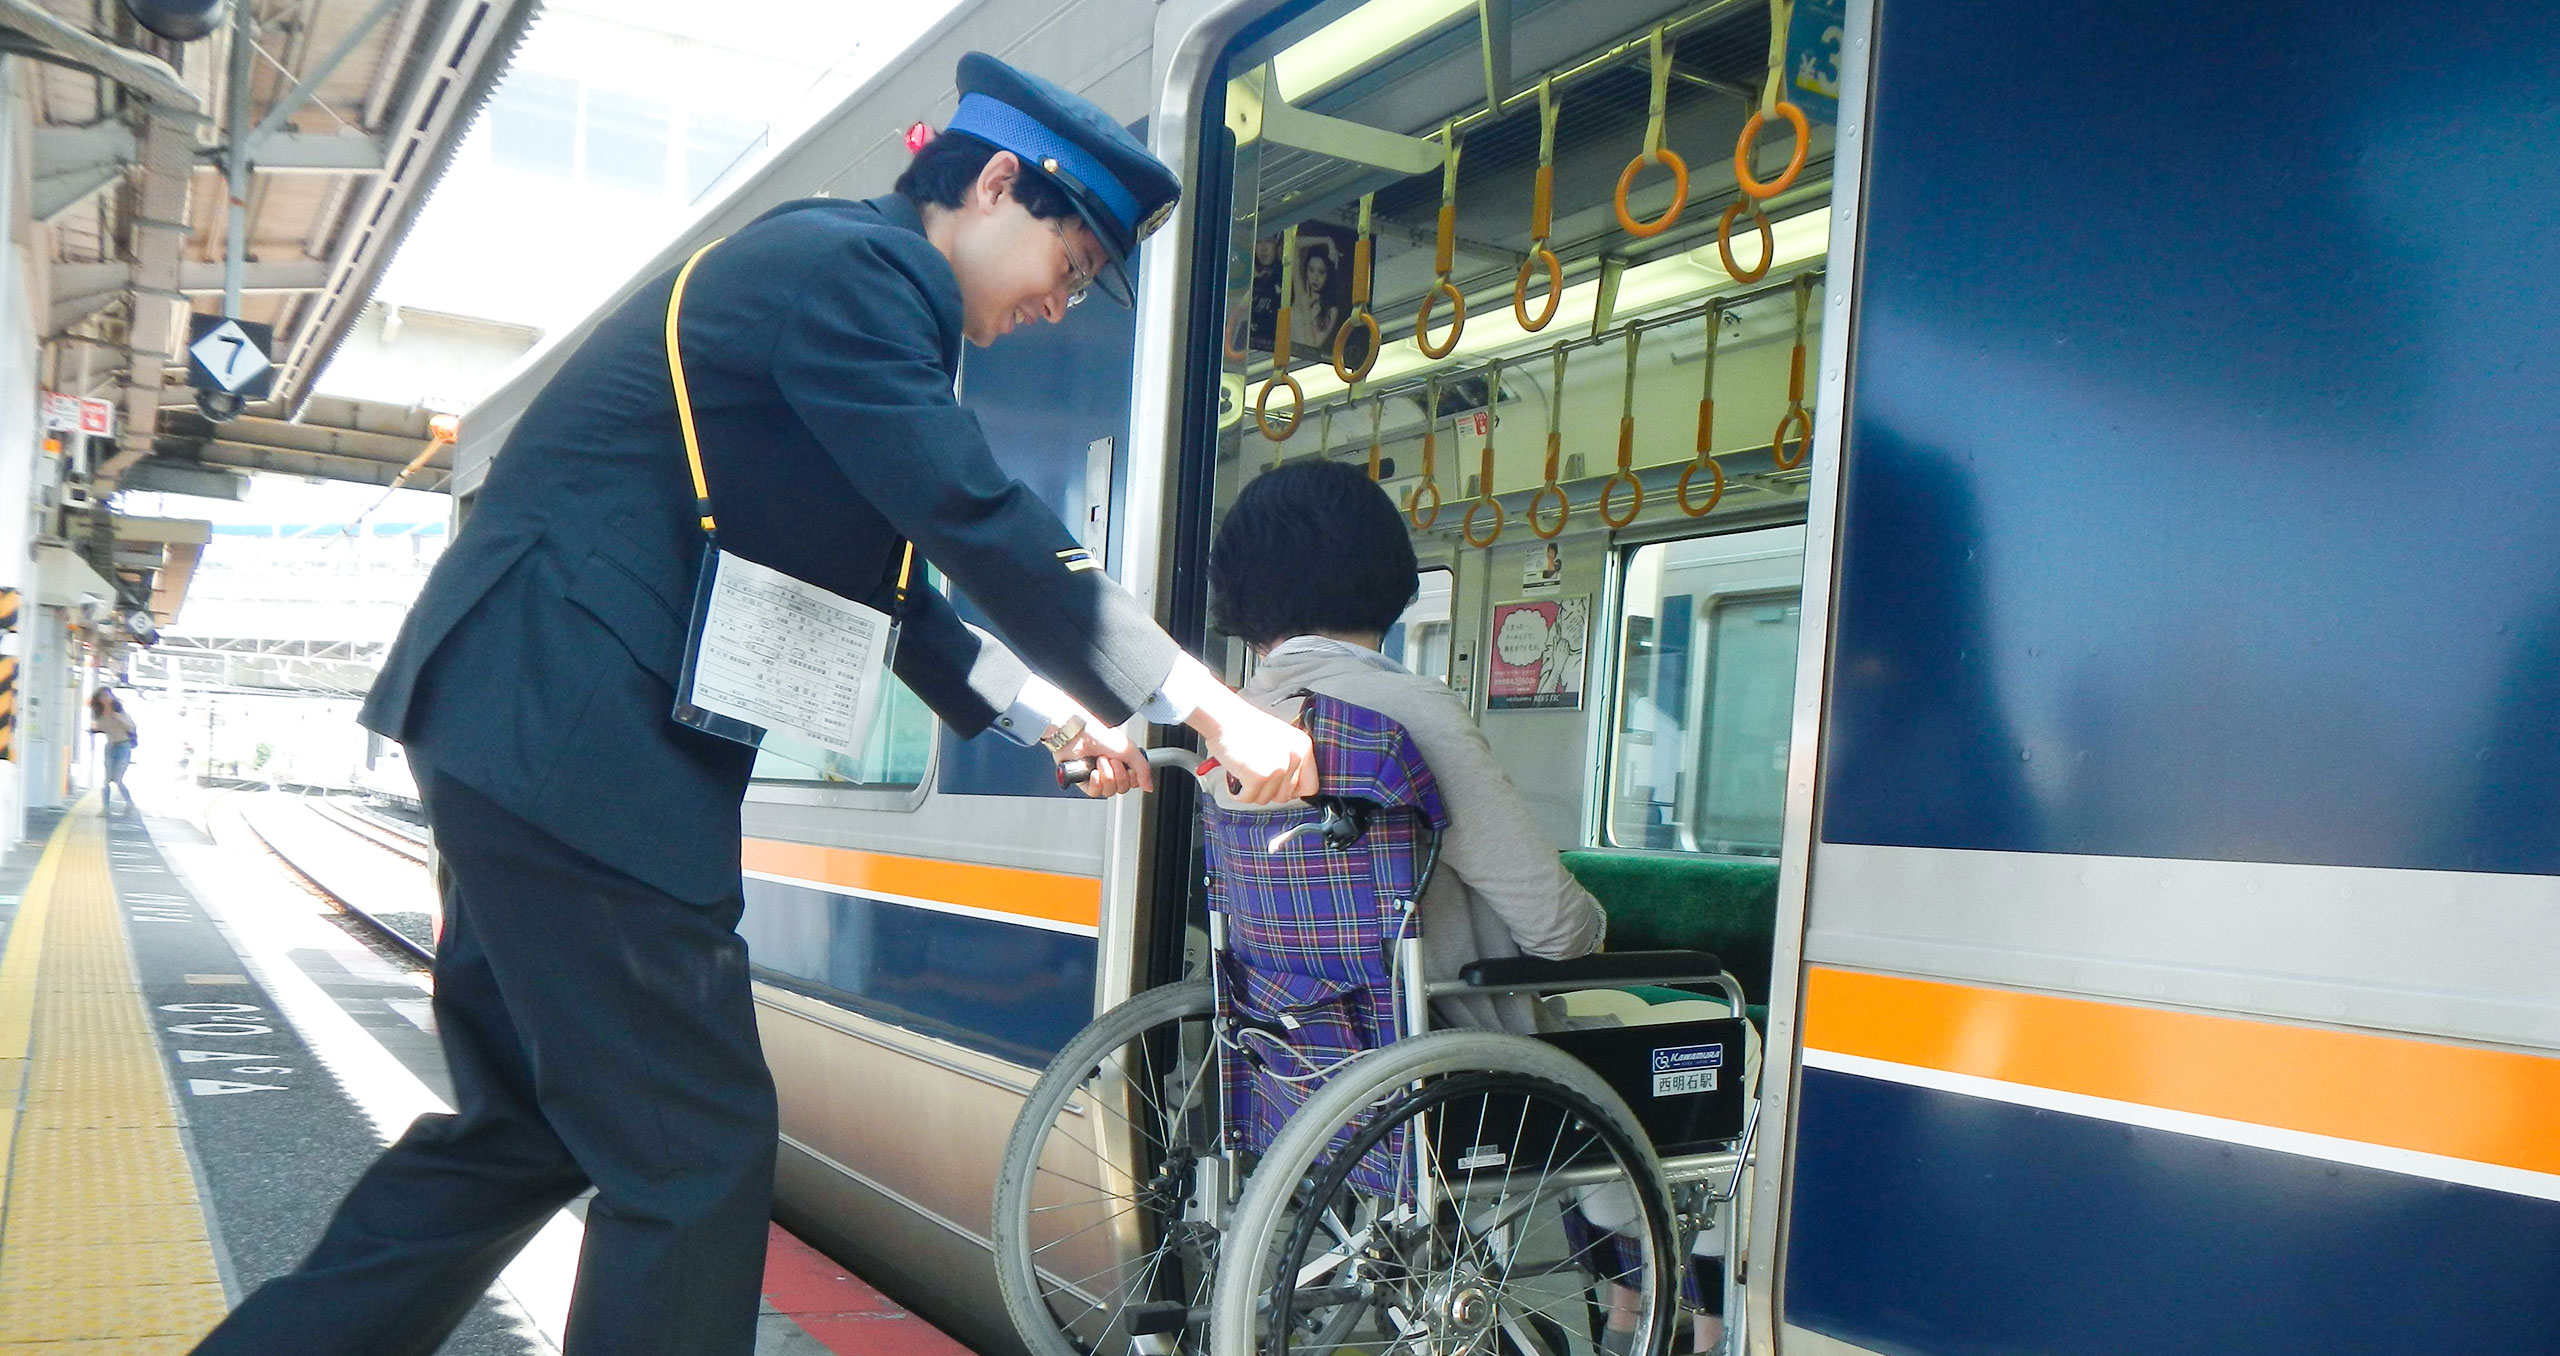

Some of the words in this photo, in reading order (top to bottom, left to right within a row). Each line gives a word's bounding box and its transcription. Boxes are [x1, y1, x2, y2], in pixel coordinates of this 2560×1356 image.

[217, 335, 245, 375] 7
[1659, 1072, 1712, 1093] 西明石駅
